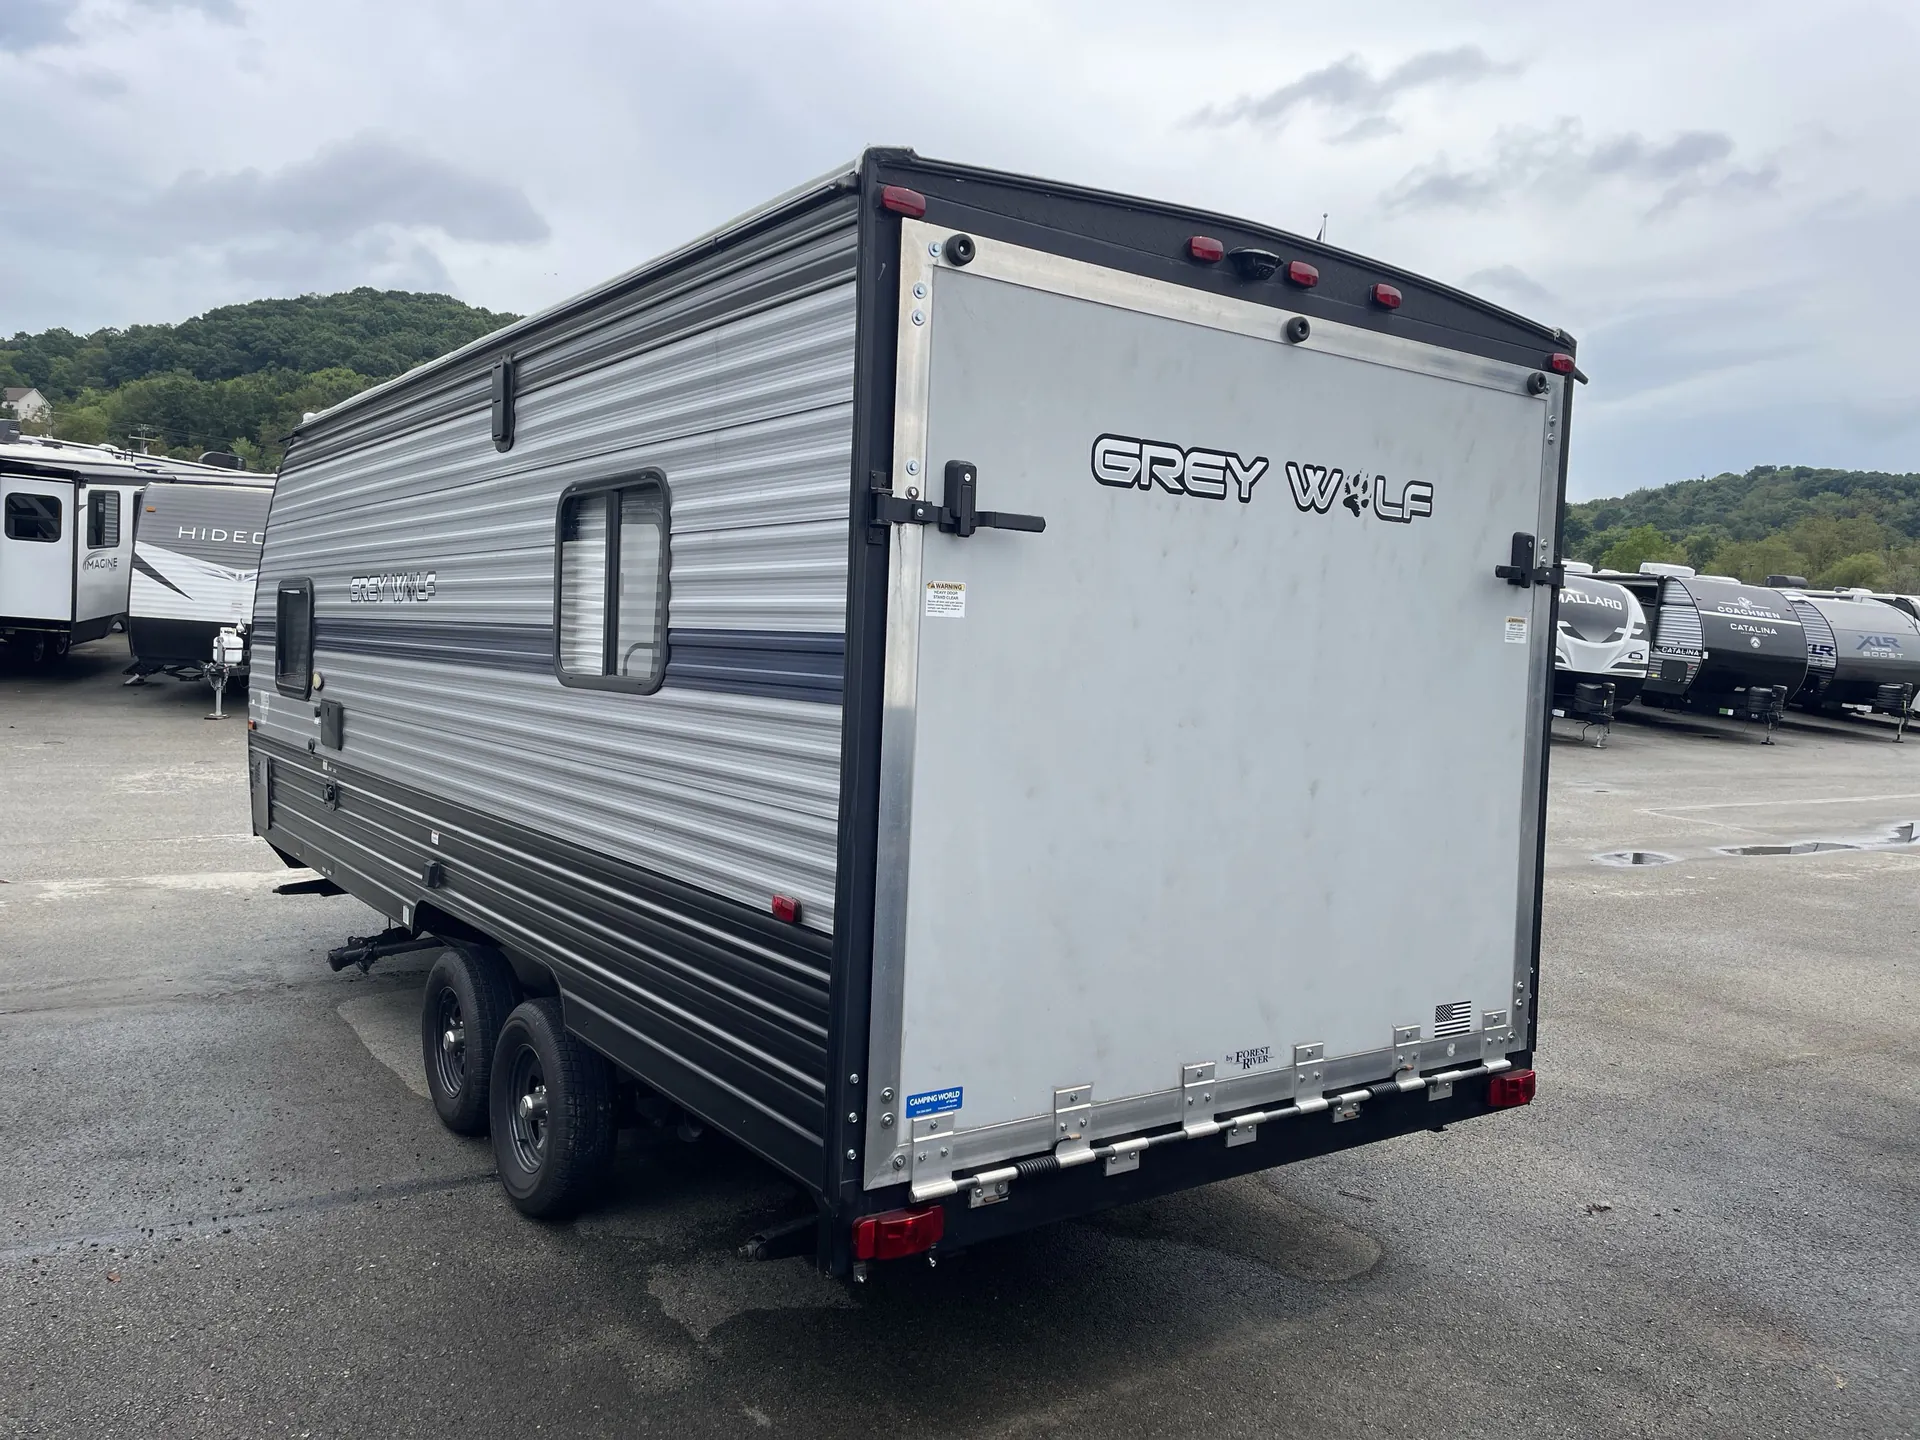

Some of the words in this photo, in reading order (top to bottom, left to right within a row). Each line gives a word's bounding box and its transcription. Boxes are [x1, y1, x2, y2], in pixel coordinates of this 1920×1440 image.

[1091, 433, 1269, 503] GREY
[84, 557, 118, 570] IMAGINE
[350, 573, 388, 602] GREY
[1717, 606, 1781, 619] COACHMEN
[1730, 622, 1778, 636] CATALINA
[1856, 635, 1902, 650] XLR
[1661, 646, 1700, 657] CATALINA
[1235, 1046, 1270, 1063] FOREST
[1243, 1055, 1269, 1070] RIVER
[909, 1094, 938, 1106] CAMPING
[938, 1090, 960, 1101] WORLD
